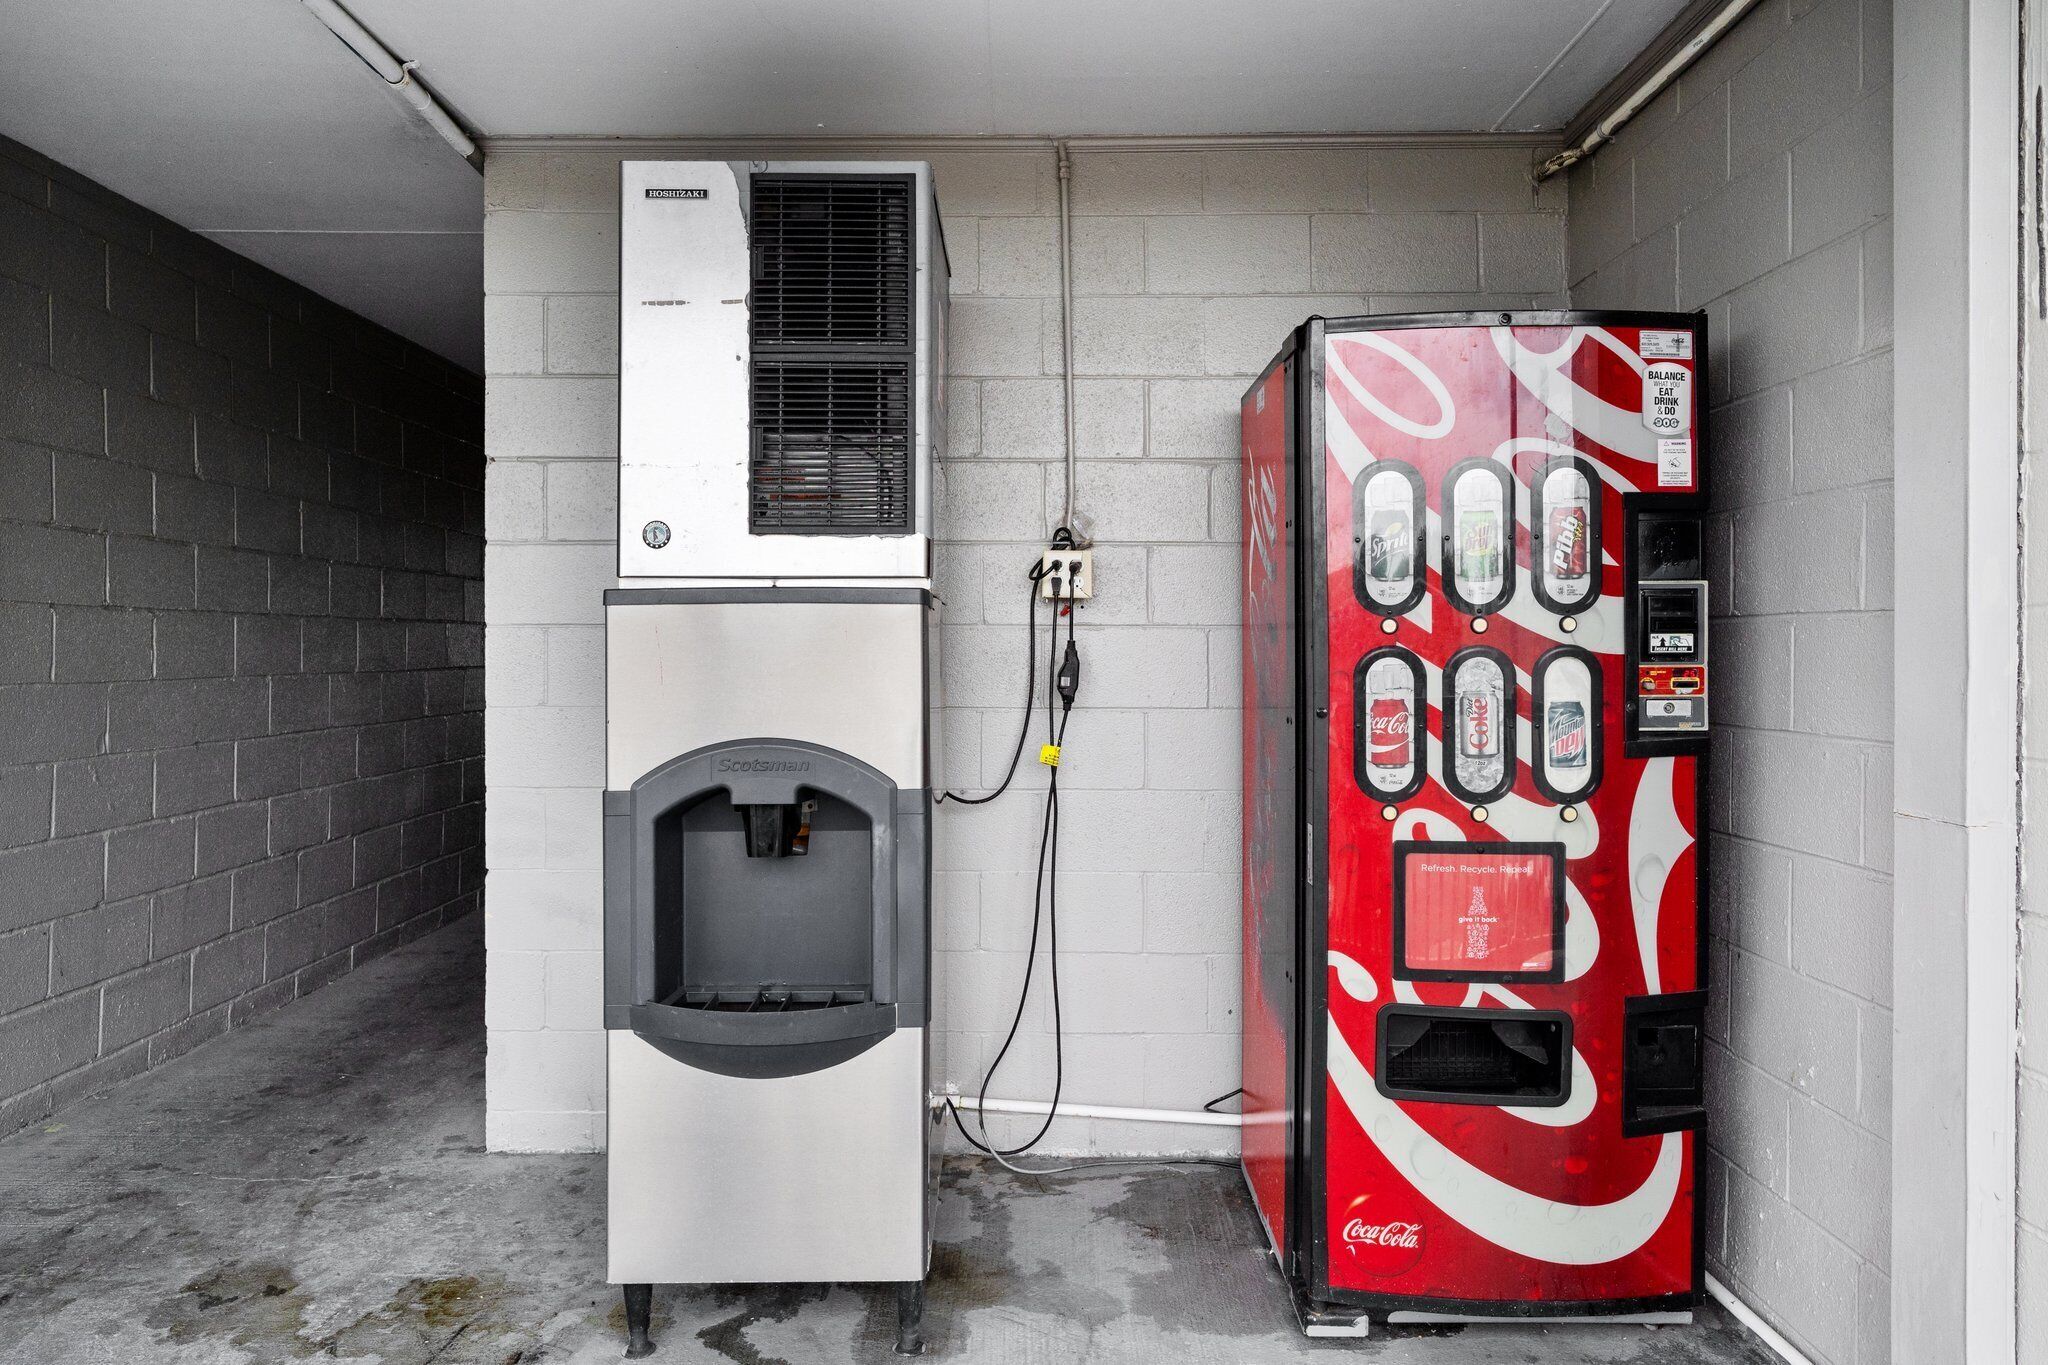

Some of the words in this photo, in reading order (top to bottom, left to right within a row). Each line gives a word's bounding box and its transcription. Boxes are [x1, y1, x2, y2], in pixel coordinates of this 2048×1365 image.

[649, 190, 704, 198] HOSHIZAKI
[1648, 370, 1686, 381] BALANCE
[1653, 380, 1668, 388] WHAT
[1670, 381, 1681, 389] YOU
[1659, 387, 1674, 396] EAT
[1654, 396, 1679, 406] DRINK
[1657, 406, 1663, 415] &
[1664, 406, 1676, 415] DO
[1553, 515, 1578, 570] Pibb
[1469, 697, 1489, 750] Coke
[718, 758, 811, 773] Scotsman
[1421, 863, 1458, 873] Refresh.
[1460, 864, 1498, 875] Recycle.
[1458, 916, 1473, 924] give
[1342, 1218, 1423, 1249] Coca-Cola
